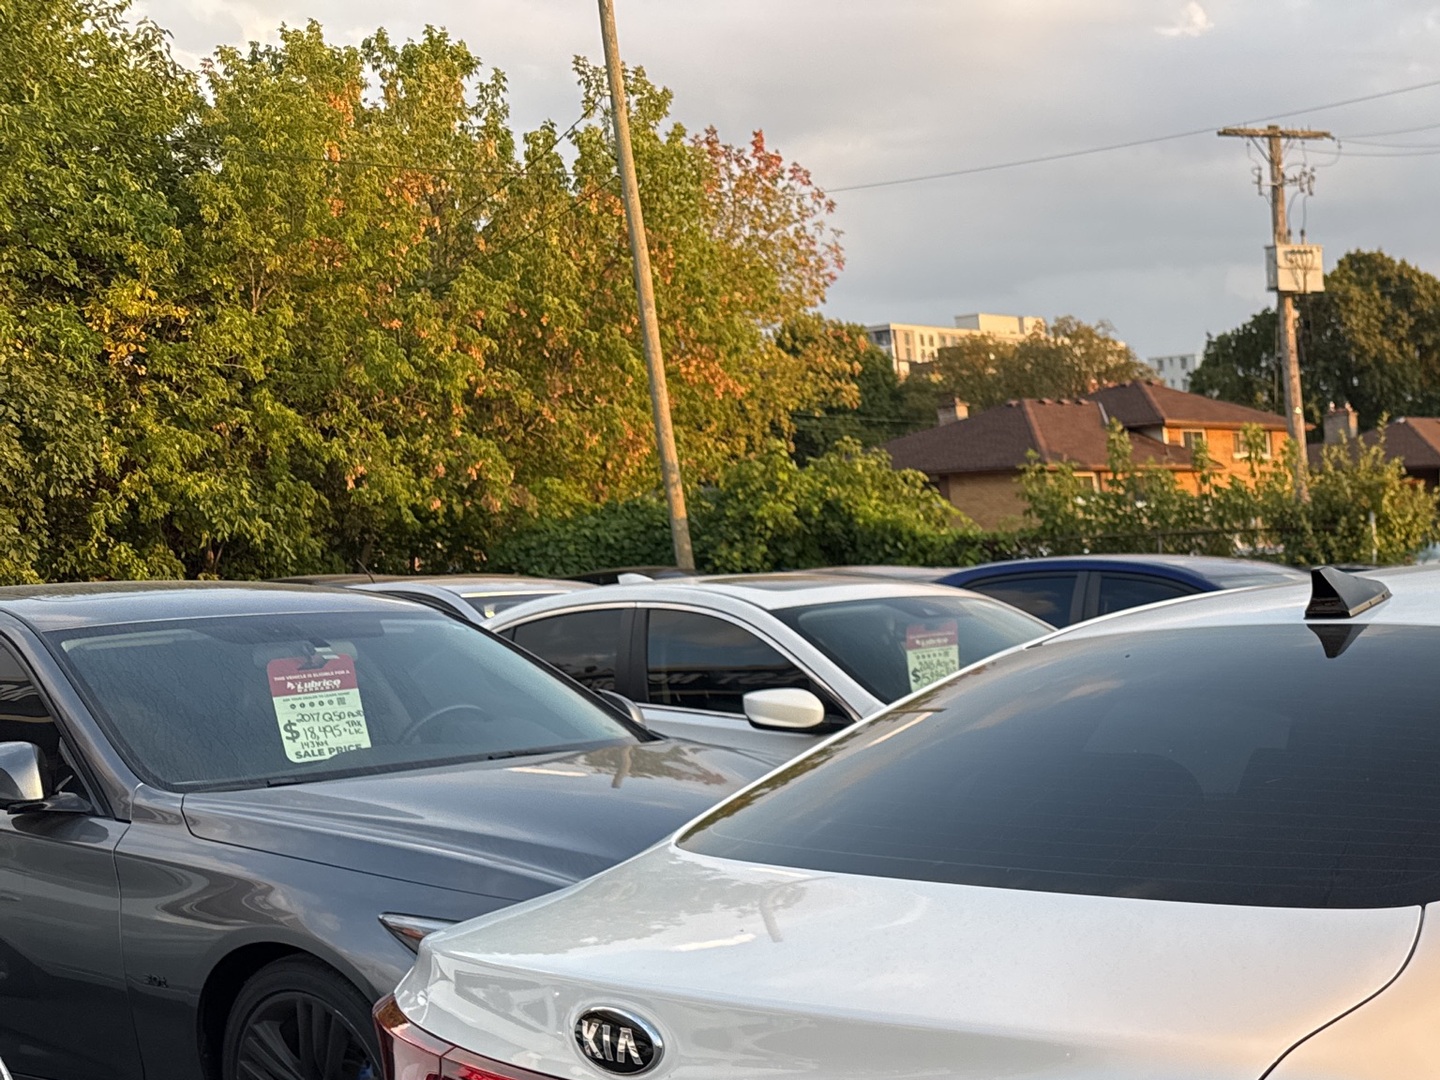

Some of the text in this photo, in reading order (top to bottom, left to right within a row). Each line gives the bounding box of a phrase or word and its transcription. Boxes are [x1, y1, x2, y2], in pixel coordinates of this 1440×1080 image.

[296, 712, 320, 722] 2017
[322, 711, 346, 722] Q50
[346, 720, 362, 728] TAX
[303, 724, 342, 740] 18,495
[295, 748, 325, 759] SALE
[581, 1019, 644, 1065] KIA
